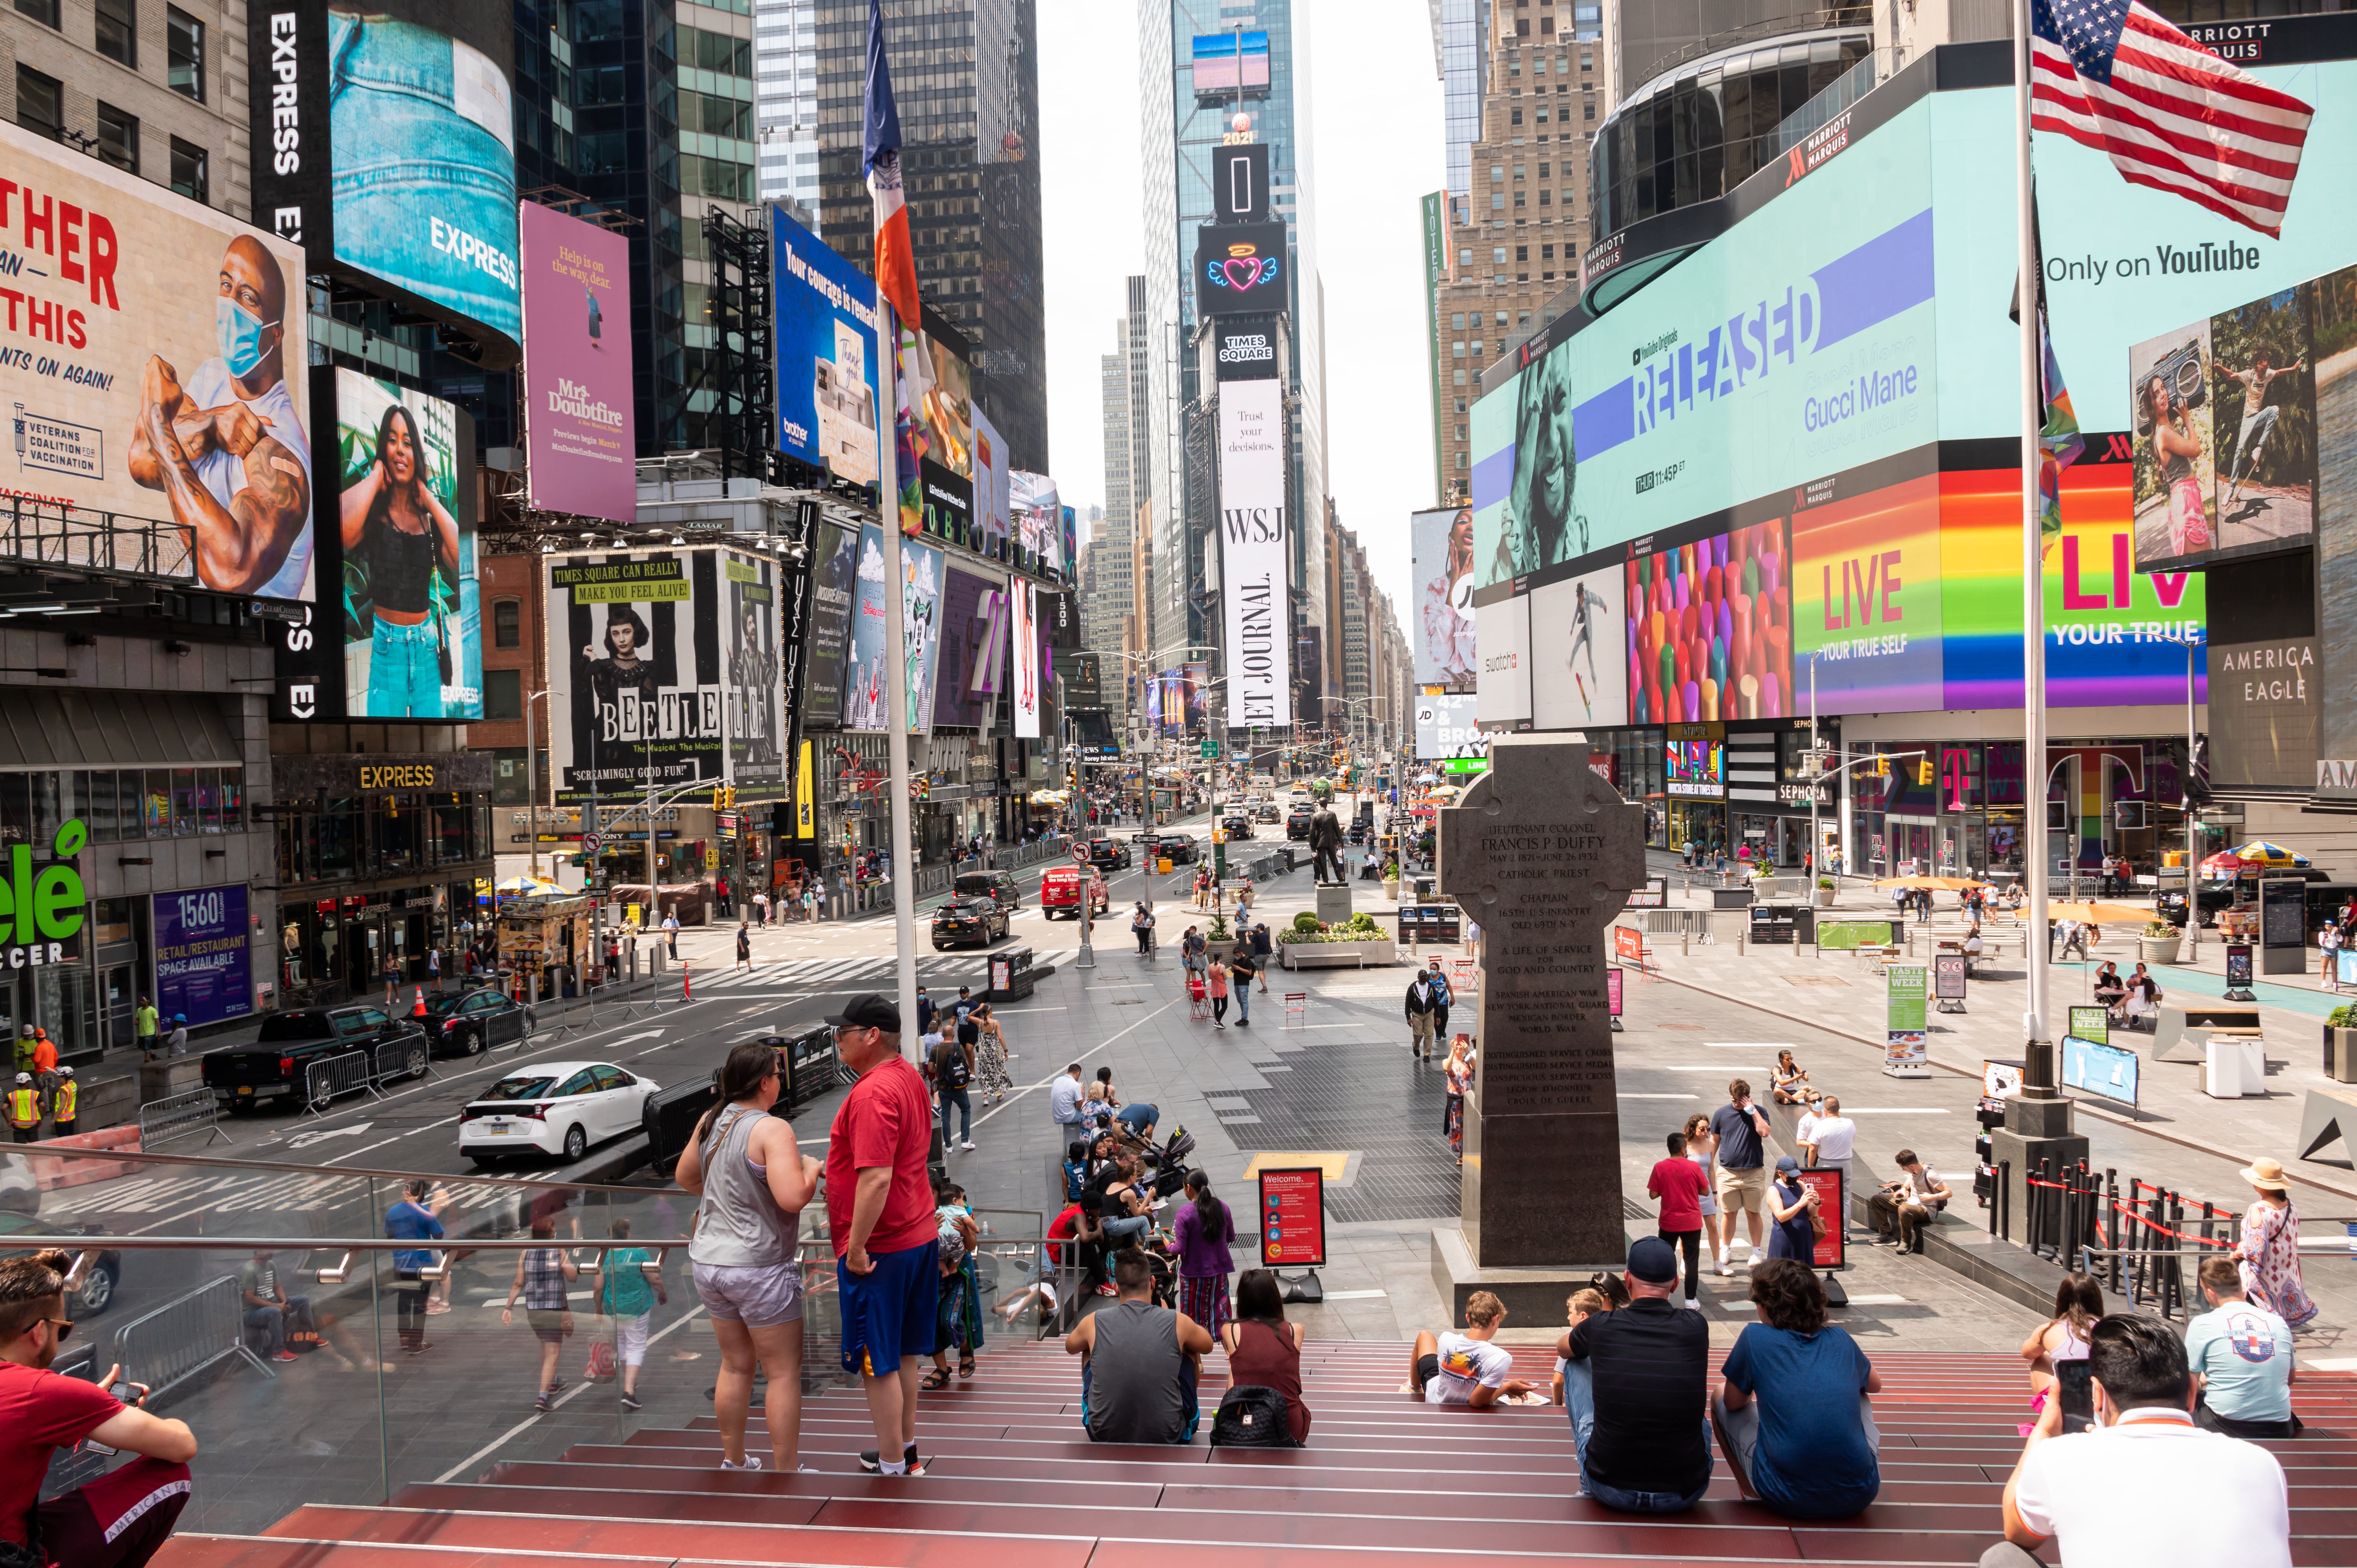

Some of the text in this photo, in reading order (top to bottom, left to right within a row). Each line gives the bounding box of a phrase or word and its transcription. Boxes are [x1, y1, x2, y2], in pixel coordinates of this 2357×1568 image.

[271, 12, 299, 176] EXPRESS
[1223, 131, 1253, 146] 2021
[1808, 112, 1852, 152] MARRIOTT
[1809, 133, 1846, 168] MARQUIS
[431, 216, 516, 290] EXPRESS
[560, 246, 604, 273] Help is on
[1587, 233, 1625, 265] MARRIOTT
[1588, 250, 1620, 279] MARQUIS
[2047, 240, 2260, 285] Only on YouTube
[552, 259, 611, 289] the way, dear.
[786, 241, 850, 312] Your courage is
[1225, 335, 1266, 348] TIMES
[1641, 327, 1677, 361] YouTube Originals
[840, 338, 860, 370] Thank
[1220, 346, 1273, 362] SQUARE
[1633, 275, 1821, 435] RELEASED
[37, 357, 114, 392] ON AGAIN!
[847, 367, 858, 388] you
[559, 378, 590, 400] Mrs.
[1804, 364, 1917, 432] Gucci Mane
[548, 391, 622, 426] Doubtfire
[1238, 411, 1264, 421] Trust
[29, 422, 80, 442] VETERANS
[553, 428, 616, 448] Previews begin March
[784, 418, 808, 442] brother
[1240, 428, 1262, 439] your
[30, 436, 81, 455] COALITION
[1229, 442, 1274, 452] decisions.
[31, 450, 94, 471] VACCINATION
[1636, 460, 1685, 493] THUR 11:45P ET
[1807, 478, 1835, 494] MARRIOTT
[1807, 489, 1832, 503] MARQUIS
[1223, 507, 1284, 544] WSJ
[1635, 536, 1653, 547] MARRIOTT
[555, 562, 678, 583] TIMES SQUARE CAN REALLY
[579, 583, 687, 600] MAKE YOU FEEL ALIVE!
[1823, 550, 1903, 631] LIVE
[1241, 572, 1273, 684] JOURNAL.
[2052, 620, 2199, 646] YOUR TRUE
[1822, 633, 1907, 662] YOUR TRUE SELF
[1486, 651, 1511, 673] swatch
[2223, 646, 2314, 671] AMERICA
[440, 685, 478, 703] EXPRESS
[2245, 680, 2305, 701] EAGLE
[1419, 711, 1431, 720] JD
[1437, 711, 1450, 726] &
[634, 742, 723, 753] The Musical. The Musical.
[1438, 744, 1488, 758] WAY
[361, 765, 434, 788] EXPRESS
[1668, 783, 1710, 796] INVICTA STORE AT TIMES
[1489, 824, 1596, 834] LIEUTENANT COLONEL
[1482, 837, 1606, 851] FRANCIS DUFFY
[1489, 854, 1507, 862] MAY
[1579, 852, 1598, 860] 1932
[1498, 869, 1589, 879] CATHOLIC PRIEST
[1520, 894, 1568, 903] CHAPLAIN
[178, 892, 218, 928] 1560
[1500, 909, 1524, 917] 165TH
[1511, 921, 1531, 929] OLD
[1512, 946, 1532, 954] LIFE
[1553, 945, 1592, 954] SERVICE
[158, 952, 234, 977] SPACE AVAILABLE
[1497, 966, 1521, 974] GOD
[1549, 965, 1596, 973] COUNTRY
[1891, 978, 1923, 986] WEEK
[1486, 1003, 1504, 1011] NEW
[2073, 1020, 2106, 1028] WEEK
